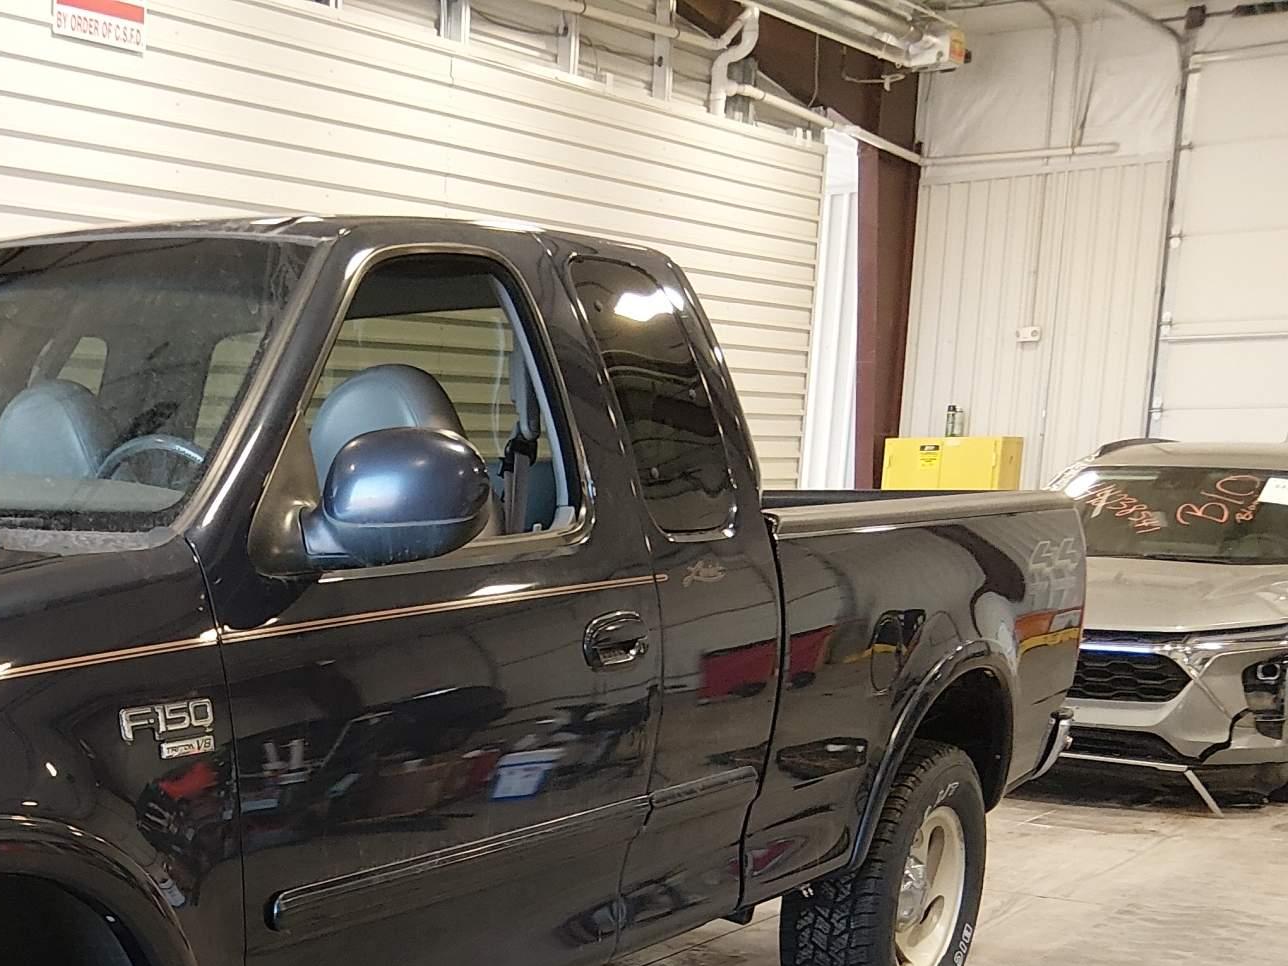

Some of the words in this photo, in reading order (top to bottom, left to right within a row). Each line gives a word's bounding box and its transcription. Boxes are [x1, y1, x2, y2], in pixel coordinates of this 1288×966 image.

[56, 11, 67, 29] BY
[71, 14, 99, 37] ORDER
[102, 21, 113, 40] OF
[196, 737, 212, 752] V8
